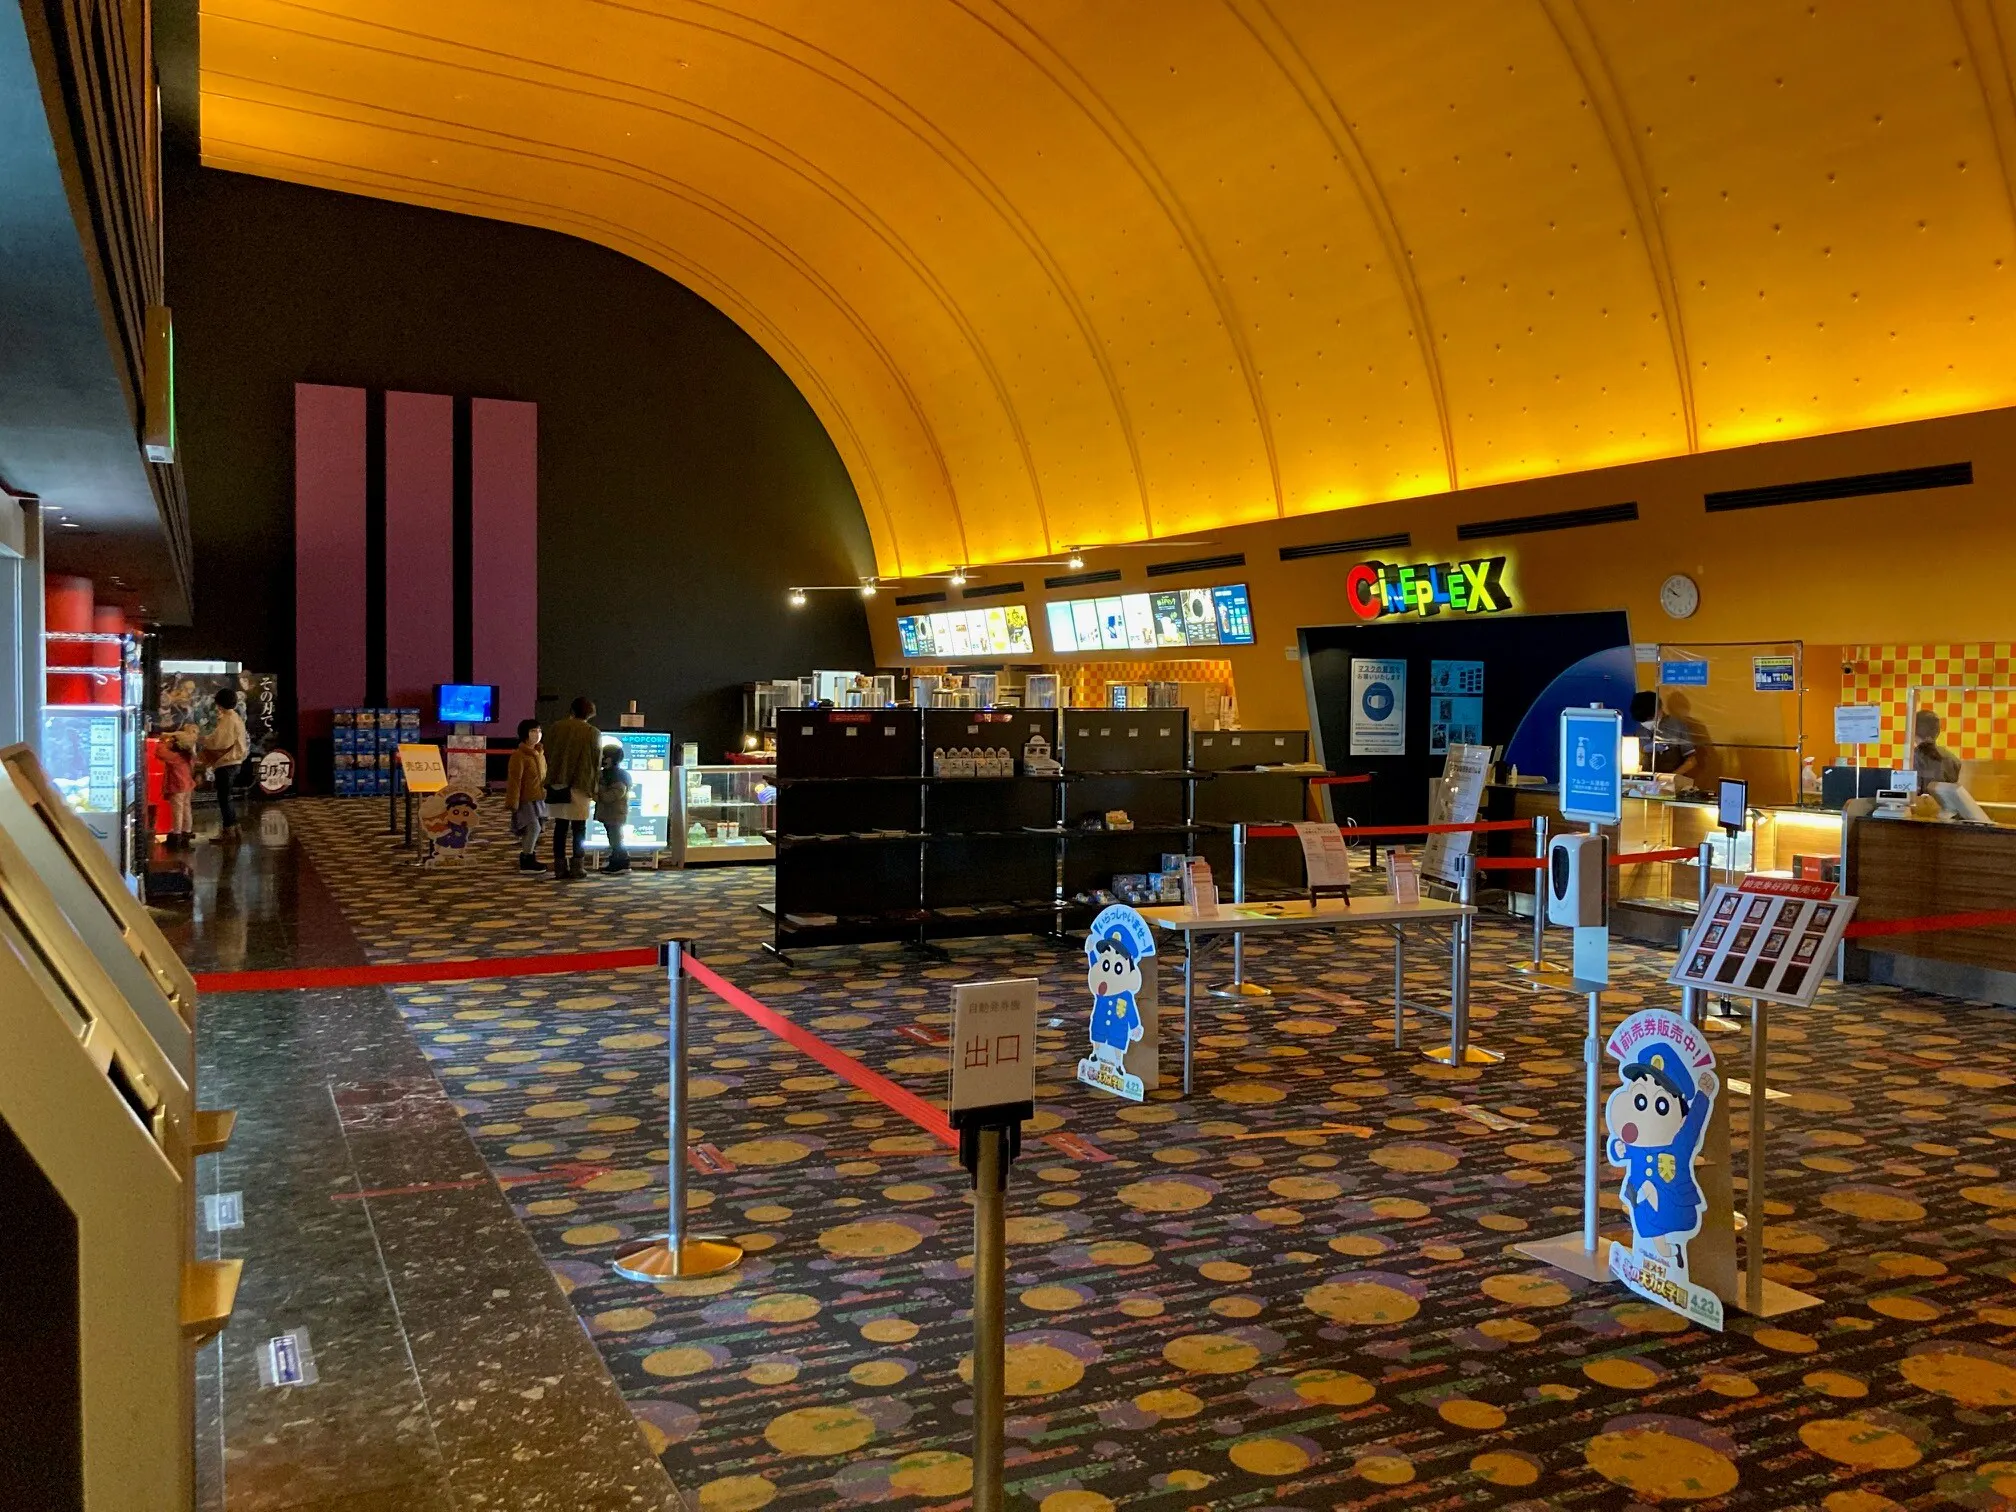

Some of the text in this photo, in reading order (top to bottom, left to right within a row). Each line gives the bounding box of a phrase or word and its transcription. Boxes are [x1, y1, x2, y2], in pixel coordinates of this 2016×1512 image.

[405, 761, 441, 772] 売店入口
[968, 1000, 1021, 1014] 自動発券機
[964, 1034, 1020, 1070] 出口
